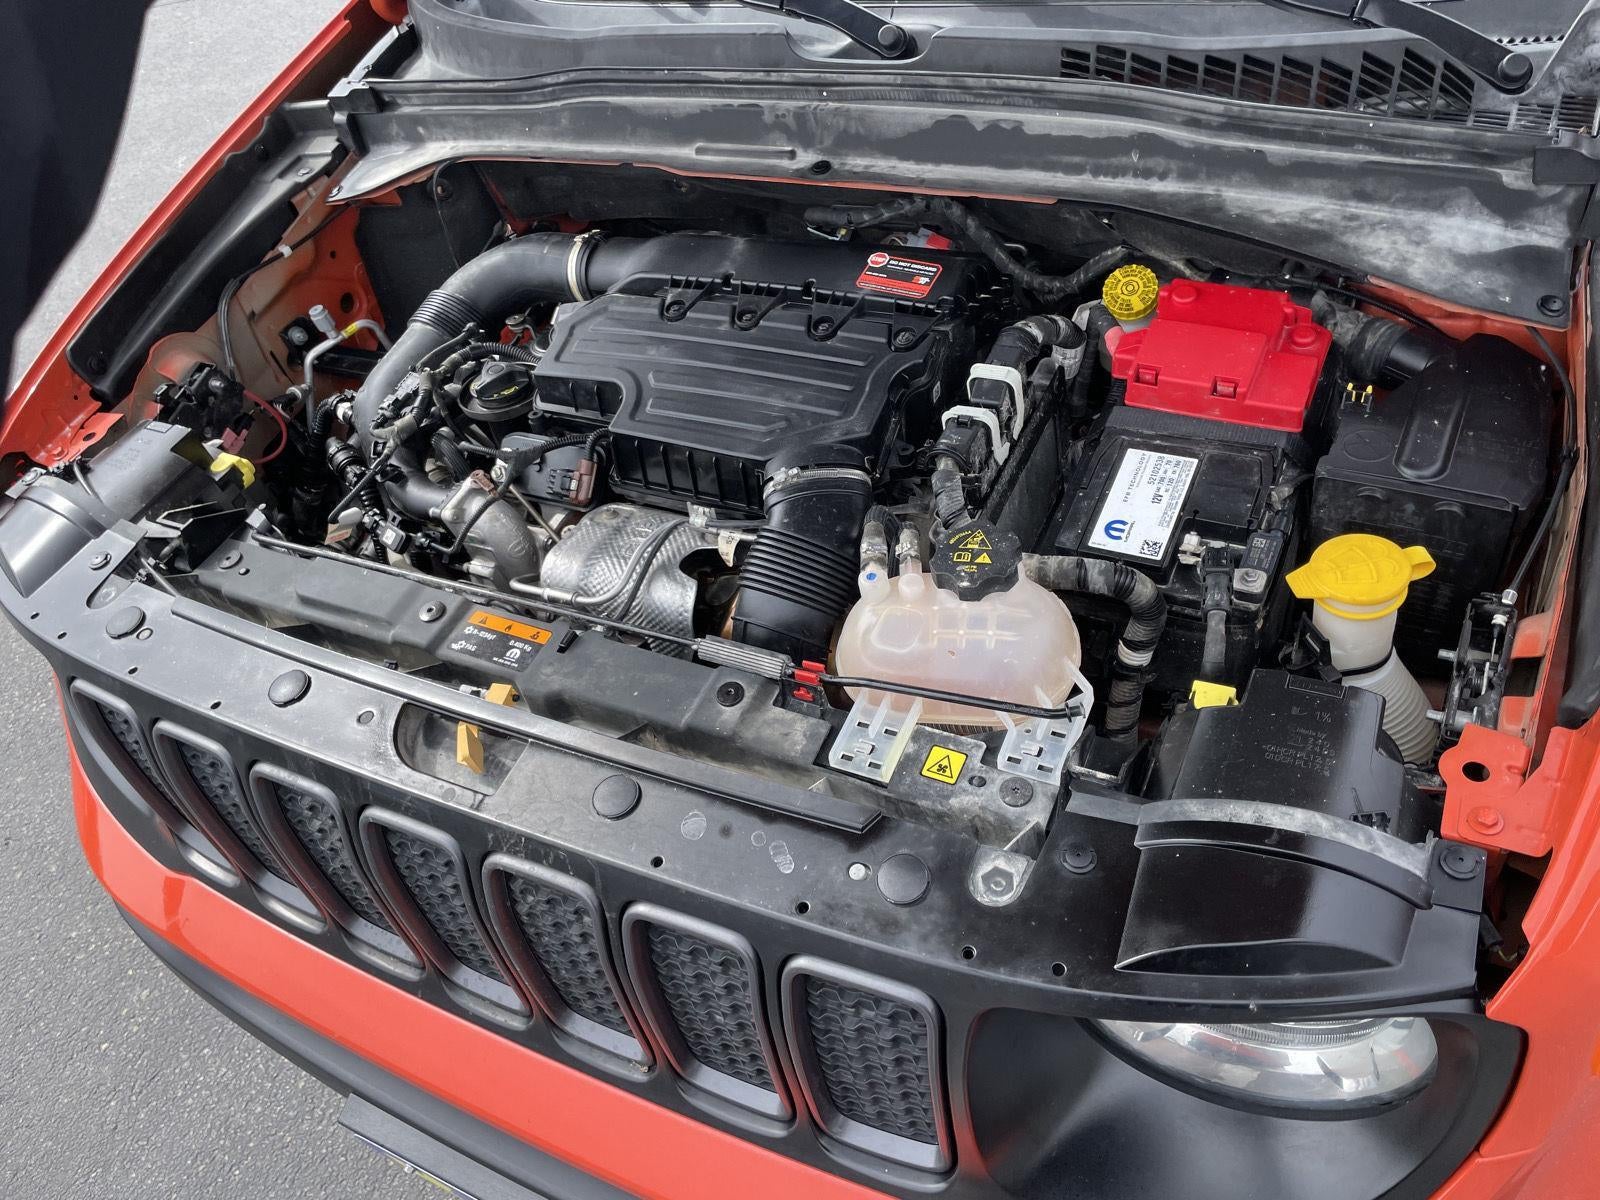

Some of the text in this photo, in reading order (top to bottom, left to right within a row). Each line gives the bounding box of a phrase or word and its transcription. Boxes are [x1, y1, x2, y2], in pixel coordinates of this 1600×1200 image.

[911, 263, 937, 272] DISCARD
[1128, 453, 1147, 490] TECHNOLOGY
[1152, 493, 1163, 504] 12V
[524, 642, 532, 651] Kg
